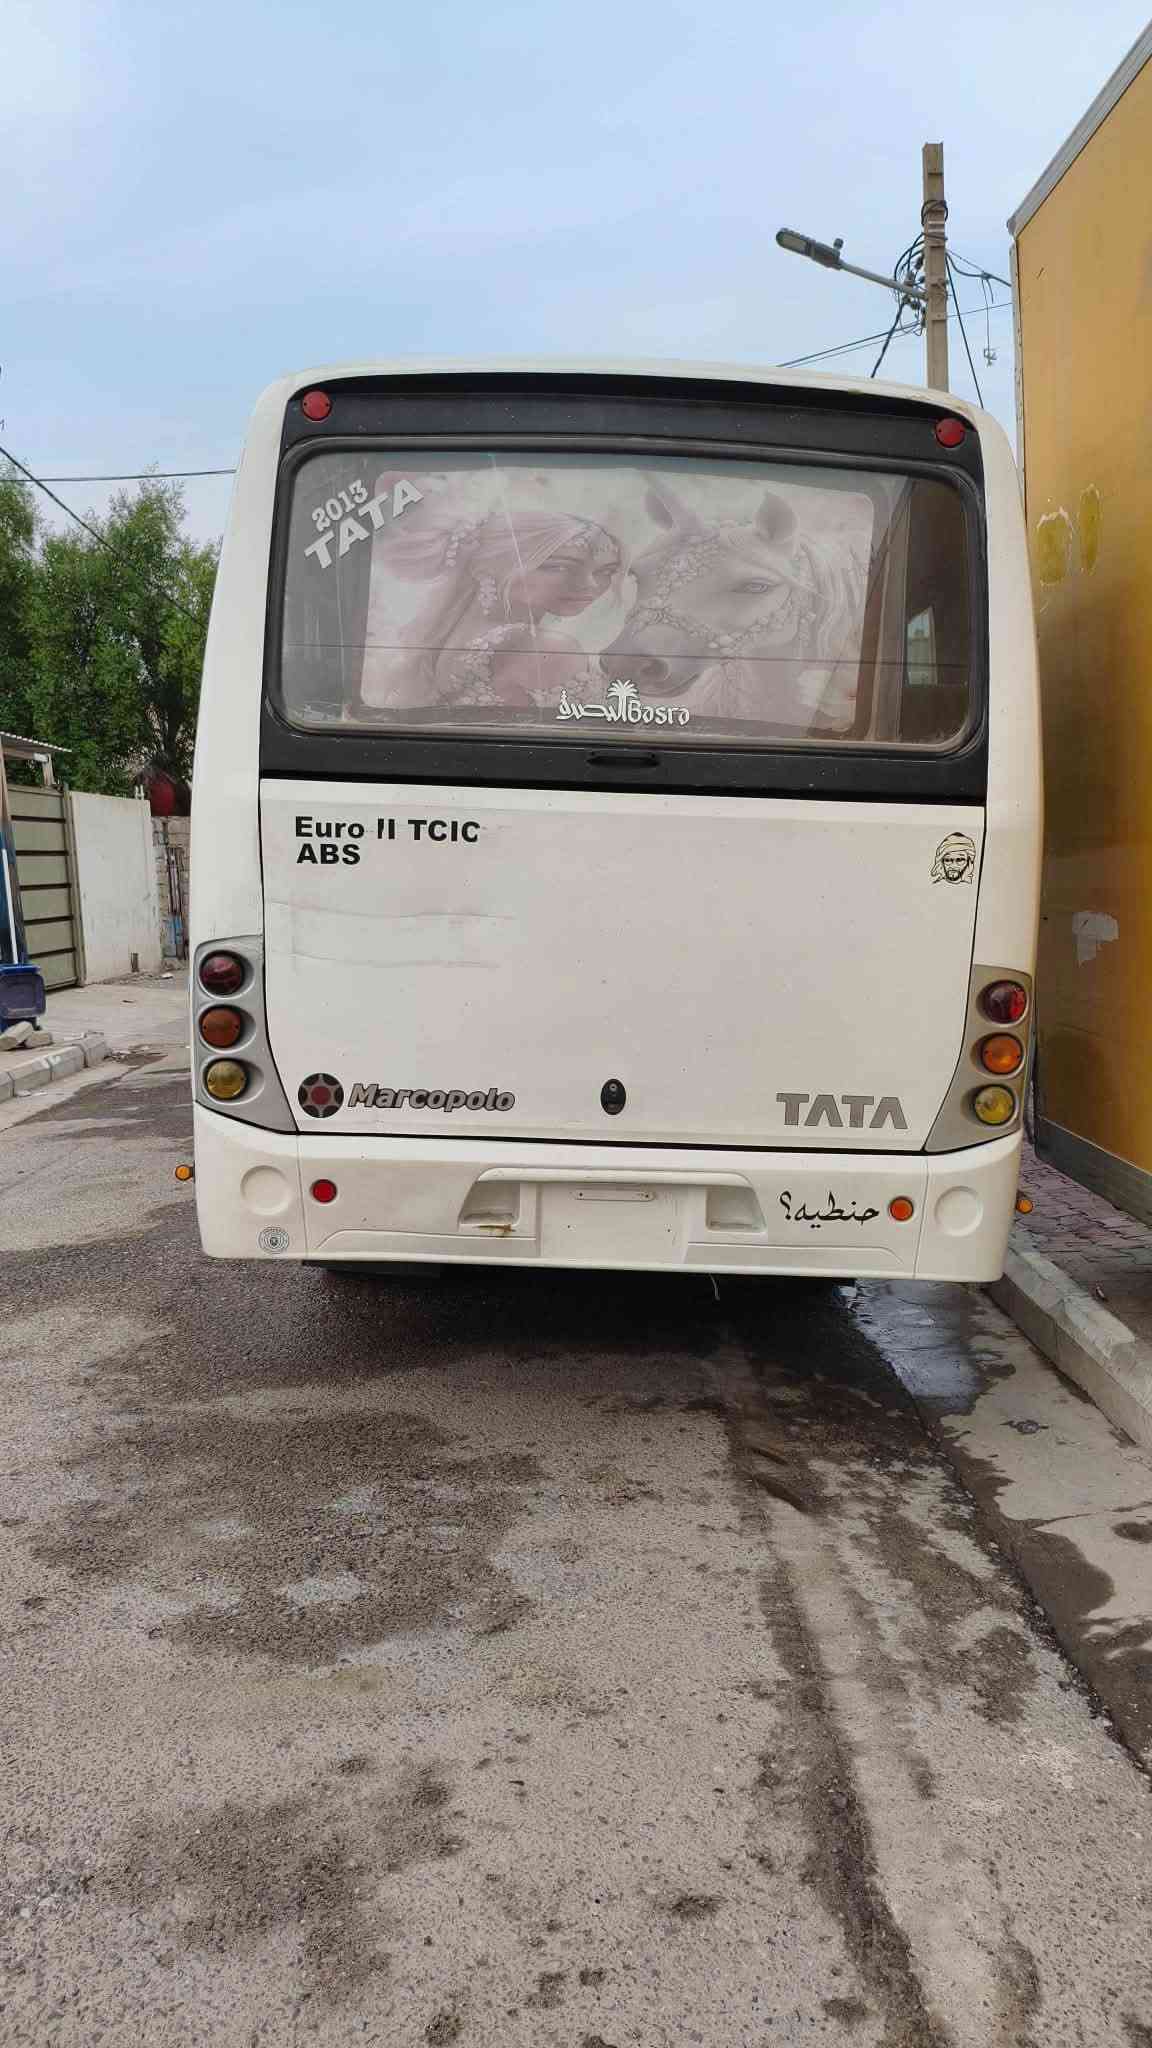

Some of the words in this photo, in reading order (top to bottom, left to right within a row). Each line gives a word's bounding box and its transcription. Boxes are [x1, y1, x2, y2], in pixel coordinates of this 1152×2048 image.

[311, 479, 369, 532] 2013
[303, 479, 425, 569] TATA
[627, 699, 690, 725] Basra
[295, 816, 365, 839] Euro
[377, 818, 396, 840] II
[407, 819, 481, 843] TCIC
[296, 842, 361, 866] ABS
[347, 1083, 515, 1112] Marcopolo
[775, 1092, 909, 1130] TATA
